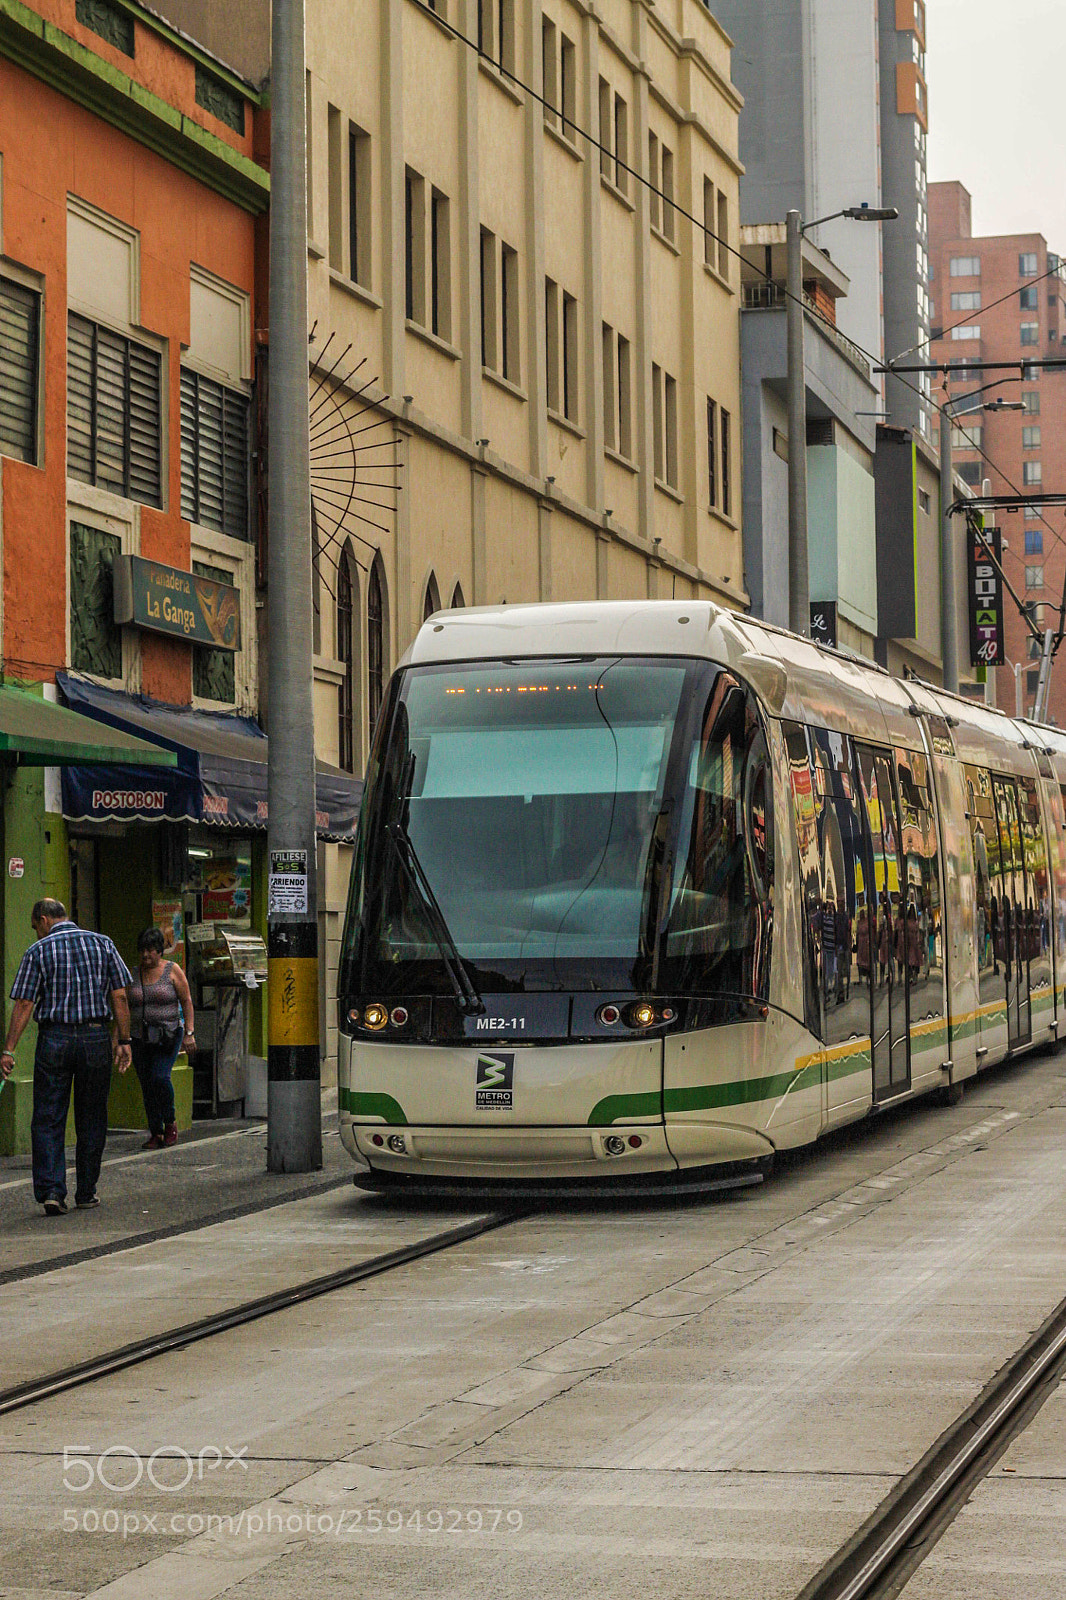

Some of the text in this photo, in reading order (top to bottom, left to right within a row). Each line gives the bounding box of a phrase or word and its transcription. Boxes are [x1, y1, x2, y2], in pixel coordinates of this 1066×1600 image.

[146, 591, 196, 633] La Ganga
[977, 640, 998, 661] 49
[92, 790, 165, 809] POSTOBON
[476, 1017, 526, 1030] ME2-11
[477, 1092, 511, 1100] METRO
